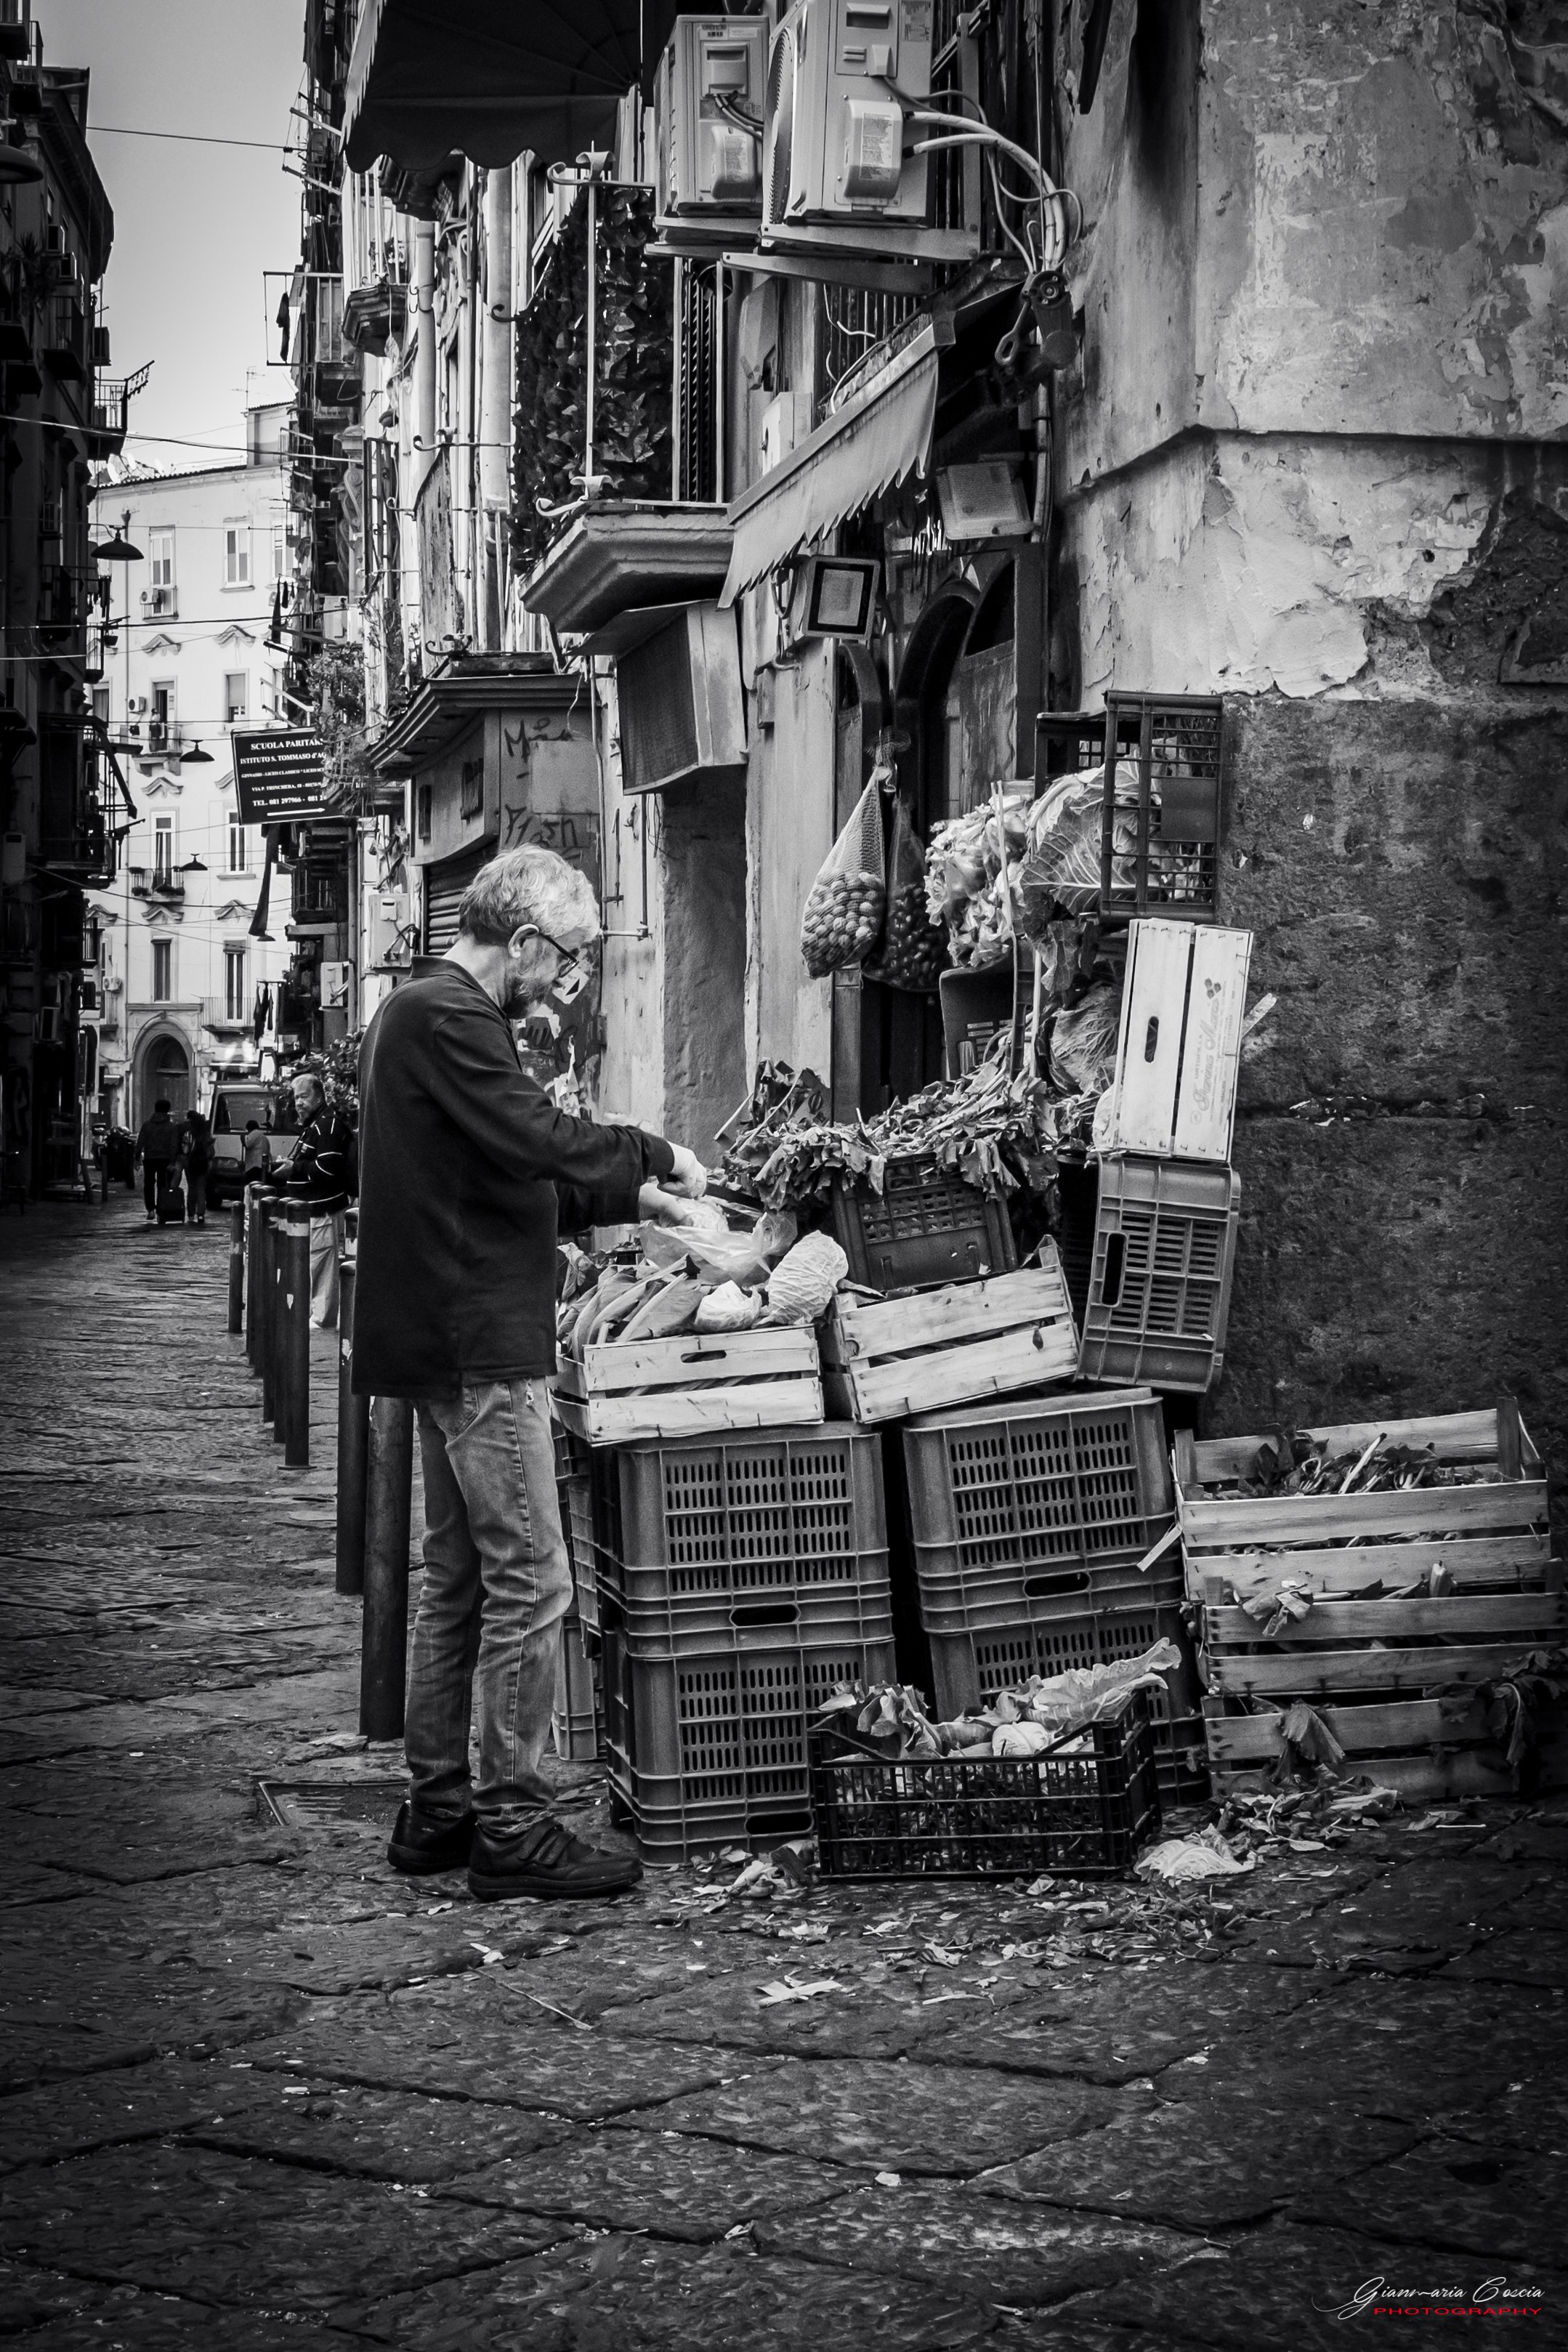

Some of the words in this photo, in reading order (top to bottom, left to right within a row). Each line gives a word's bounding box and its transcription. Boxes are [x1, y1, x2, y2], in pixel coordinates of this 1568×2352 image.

[251, 741, 284, 750] SCUOLA
[285, 738, 323, 747] PARITAR
[277, 753, 311, 761] TOMMASO
